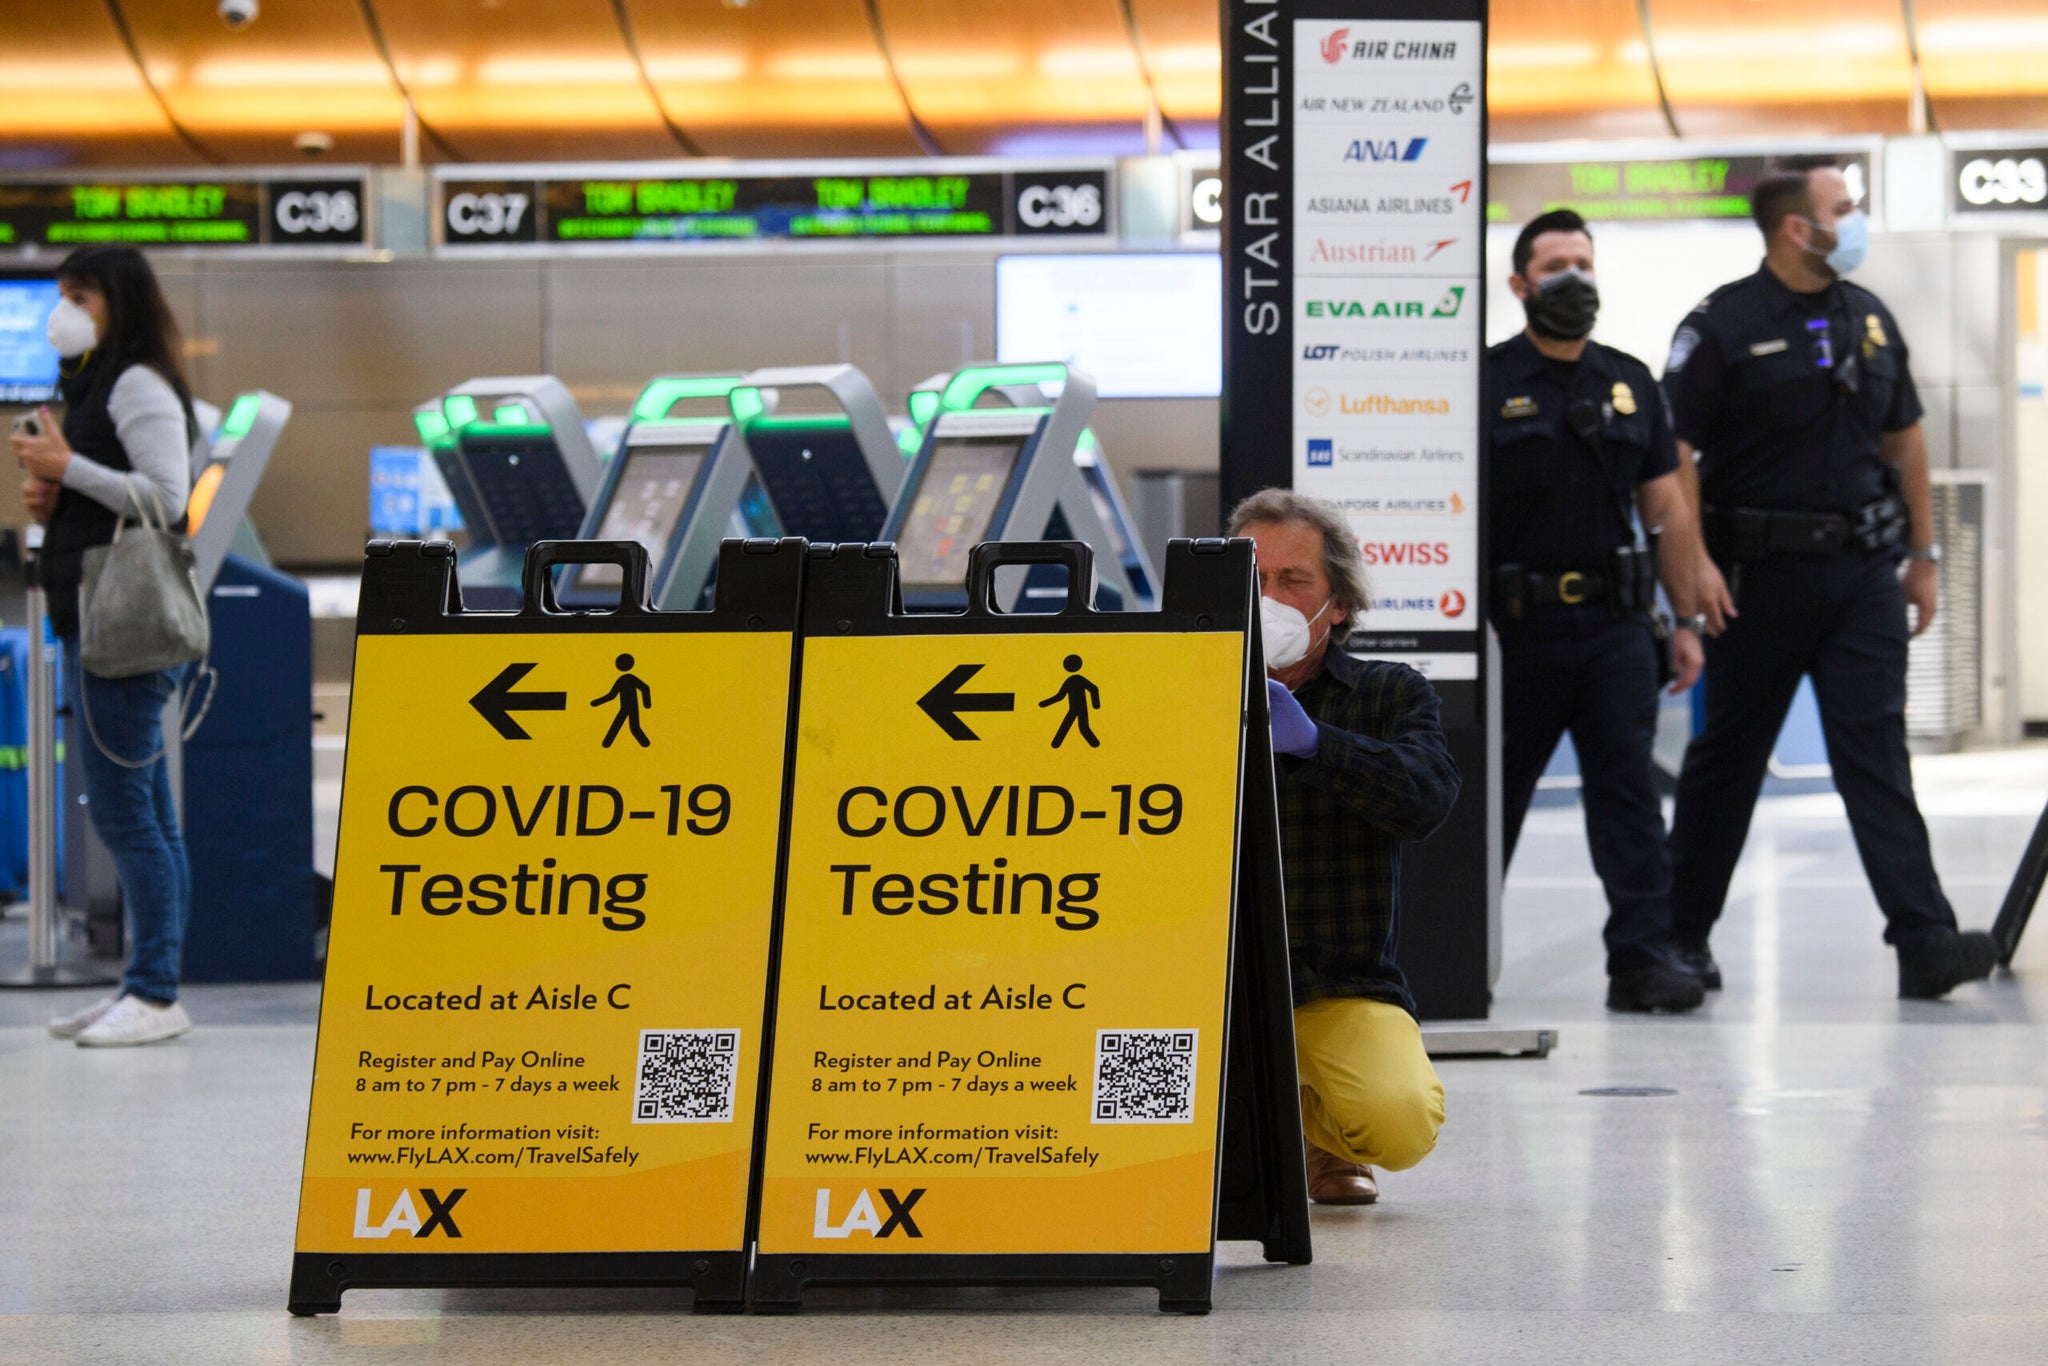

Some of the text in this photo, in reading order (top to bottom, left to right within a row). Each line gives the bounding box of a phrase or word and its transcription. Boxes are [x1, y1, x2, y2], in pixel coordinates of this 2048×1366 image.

[1353, 41, 1457, 59] AIR CHINA
[1300, 98, 1444, 112] AIR NEW ZEALAND
[1344, 140, 1399, 162] ANA
[1244, 0, 1280, 335] STAR ALLIA
[1960, 158, 2047, 204] C33
[276, 190, 358, 233] C38
[448, 193, 529, 234] C37
[1018, 184, 1101, 227] C36
[1307, 198, 1453, 214] ASIANA AIRLINES
[1310, 238, 1416, 263] Austrian
[1302, 346, 1469, 362] LOT POLISH AIRLINES
[1340, 394, 1450, 415] Lufthansa
[1338, 448, 1416, 462] Scandinavian
[1420, 447, 1465, 462] Airlines
[1333, 500, 1446, 512] APORE AIRLINES
[1363, 542, 1449, 565] SWISS
[388, 784, 731, 837] COVID-19
[838, 784, 1182, 837] COVID-19
[380, 858, 648, 931] Testing
[830, 858, 1100, 930] Testing
[366, 984, 631, 1010] Located at Aisle C
[820, 984, 1086, 1010] Located at Aisle C
[359, 1051, 584, 1072] Register and Pay Online
[815, 1051, 1041, 1072] Register and Pay Online
[356, 1078, 366, 1092] 8
[372, 1082, 400, 1092] am
[406, 1079, 425, 1092] to
[432, 1078, 442, 1092] 7
[446, 1082, 475, 1096] pm
[495, 1078, 506, 1092] 7
[511, 1075, 551, 1096] days
[557, 1081, 567, 1092] a
[573, 1075, 620, 1092] week
[811, 1078, 822, 1092] 8
[828, 1082, 856, 1092] am
[862, 1079, 881, 1092] to
[888, 1078, 897, 1092] 7
[903, 1082, 932, 1096] pm
[951, 1078, 961, 1092] 7
[967, 1075, 1008, 1096] days
[1014, 1081, 1025, 1092] a
[1030, 1075, 1077, 1092] week
[351, 1123, 600, 1140] For more information visit:
[808, 1123, 1058, 1140] For more information visit:
[348, 1146, 639, 1168] www.FlyLAX.com/TravelSafely
[806, 1146, 1099, 1168] www.FlyLAX.com/TravelSafely
[353, 1188, 467, 1239] LAX
[813, 1188, 927, 1239] LAX
